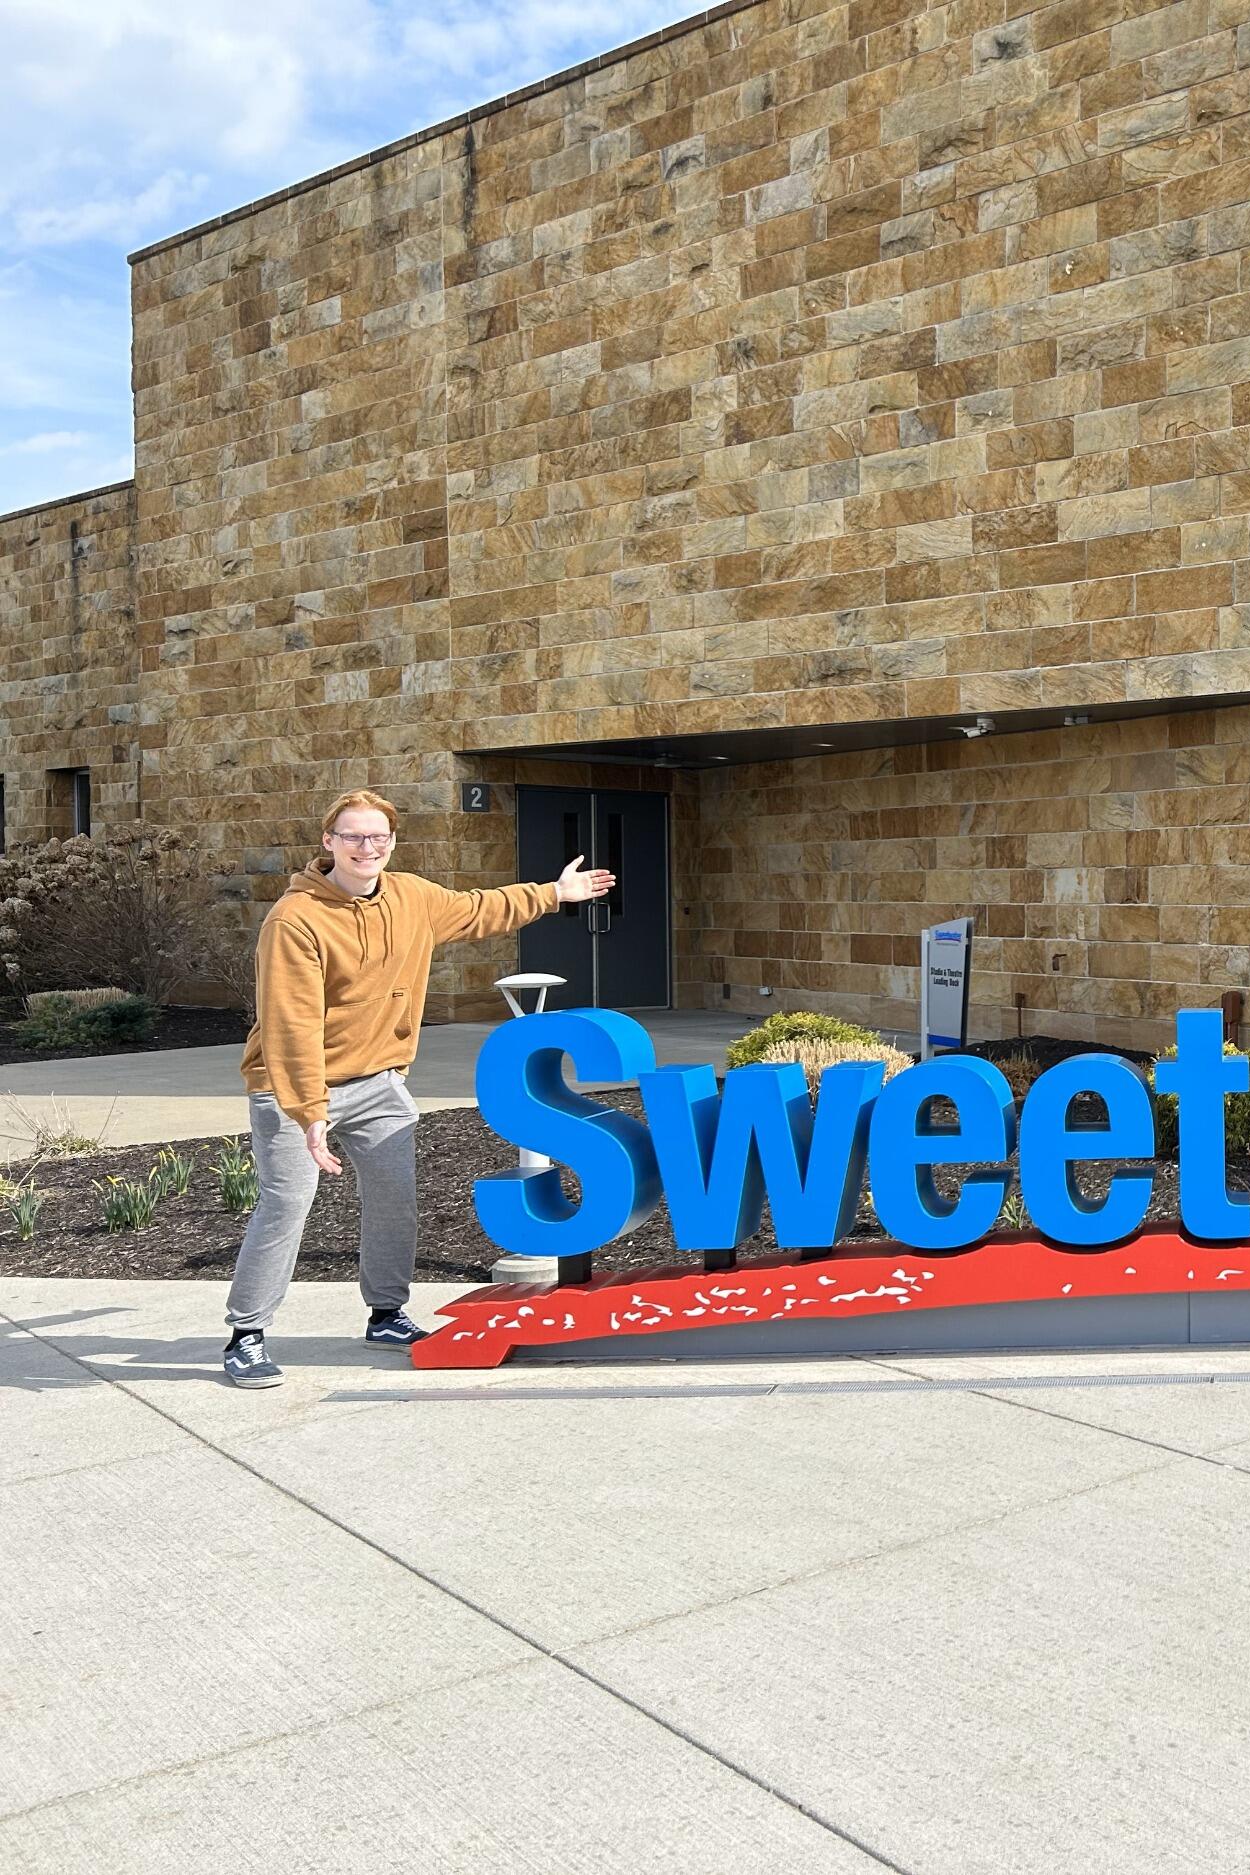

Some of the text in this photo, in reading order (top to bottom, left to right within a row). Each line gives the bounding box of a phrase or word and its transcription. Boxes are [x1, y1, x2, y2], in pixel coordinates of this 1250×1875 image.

[471, 787, 482, 808] 2
[931, 967, 943, 976] Studio
[934, 976, 959, 987] Loading Dock
